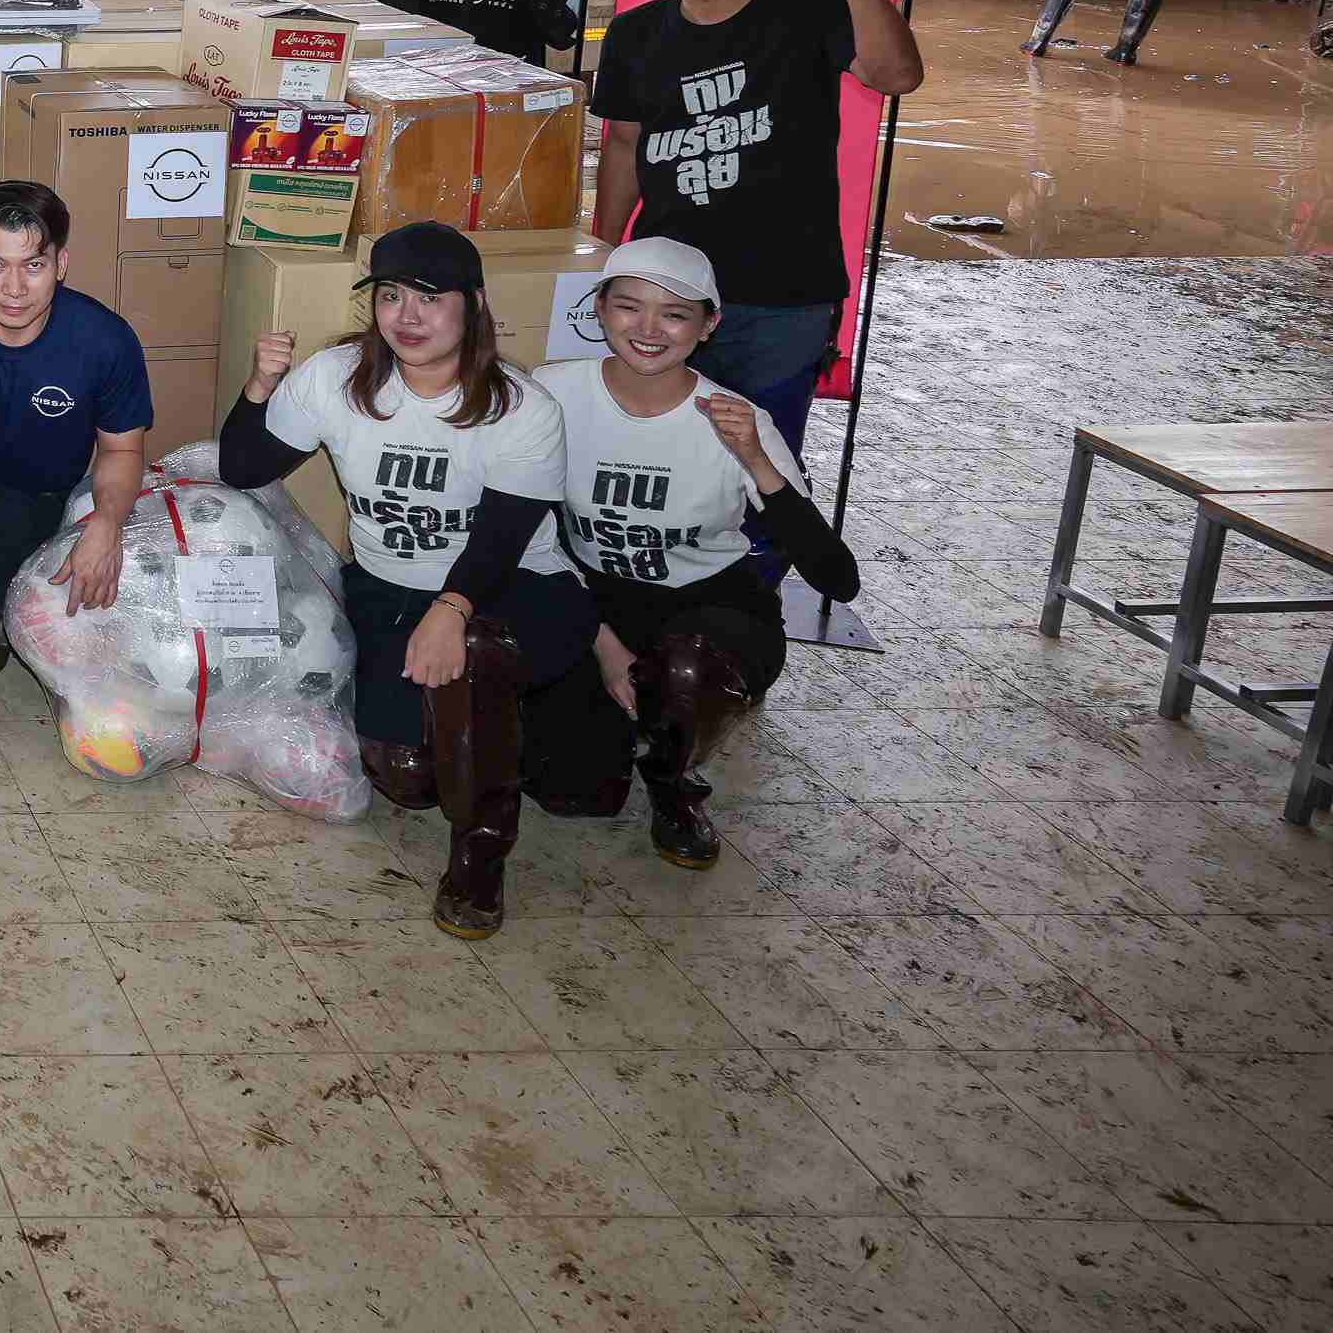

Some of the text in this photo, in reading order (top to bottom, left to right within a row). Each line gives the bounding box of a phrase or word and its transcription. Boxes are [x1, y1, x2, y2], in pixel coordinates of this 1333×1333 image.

[221, 16, 241, 31] TAPE
[291, 49, 335, 59] CLOTH TAPE
[681, 69, 746, 115] ทน
[69, 127, 128, 138] TOSHIBA
[137, 123, 221, 133] WATER DISPENSER
[646, 104, 774, 164] พร้อม
[143, 170, 211, 181] NISSAN
[676, 152, 740, 206] ลุย
[31, 396, 75, 406] NISSAN
[375, 451, 449, 493] ทน
[592, 470, 670, 511] ทน
